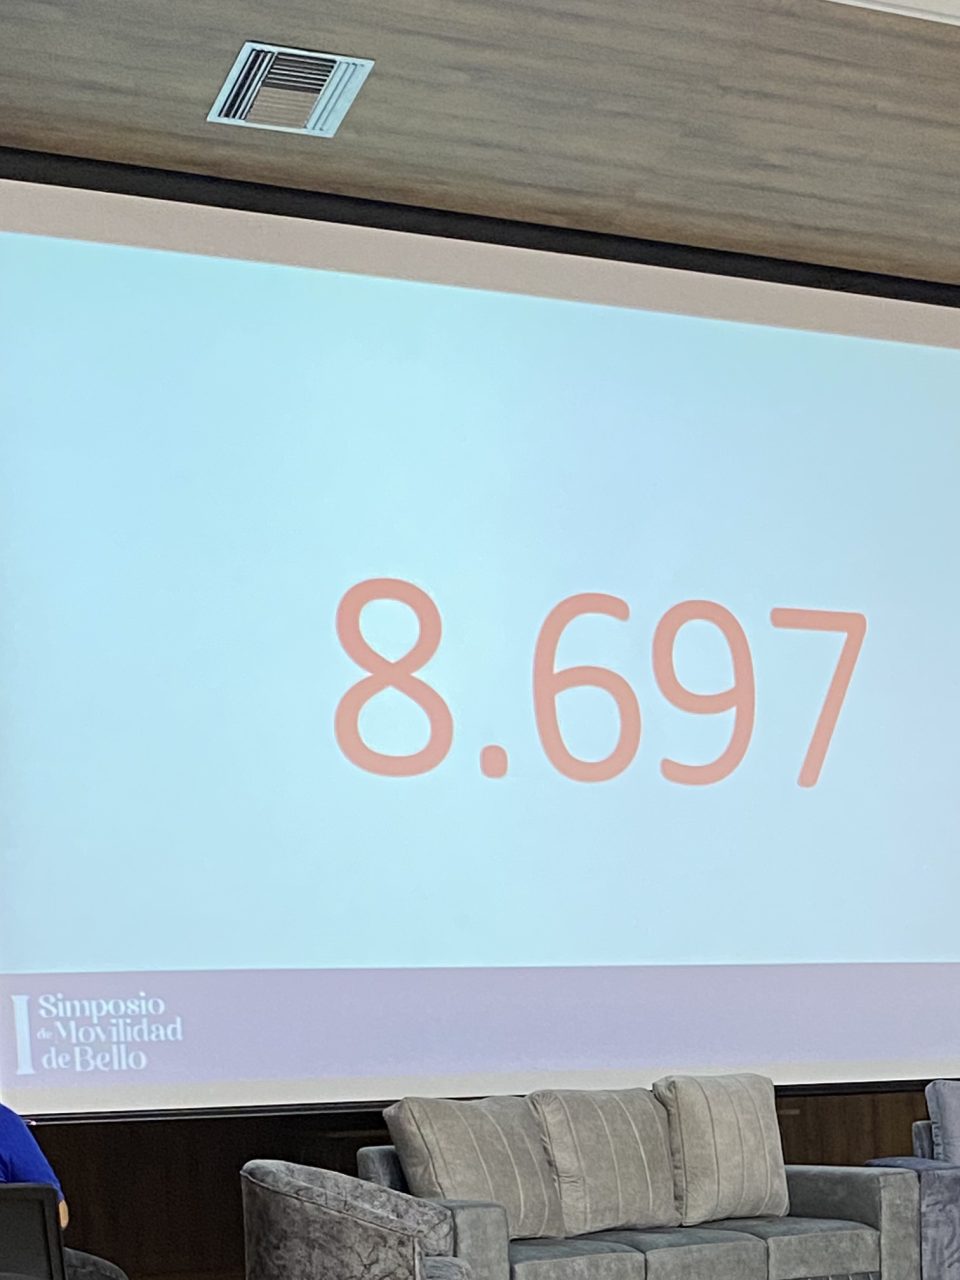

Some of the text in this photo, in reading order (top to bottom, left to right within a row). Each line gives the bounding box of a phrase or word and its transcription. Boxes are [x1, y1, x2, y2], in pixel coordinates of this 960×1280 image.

[334, 577, 867, 788] 8.697
[38, 991, 166, 1024] Simposio
[36, 1016, 183, 1044] de Movilidad
[42, 1044, 148, 1072] de Bello
